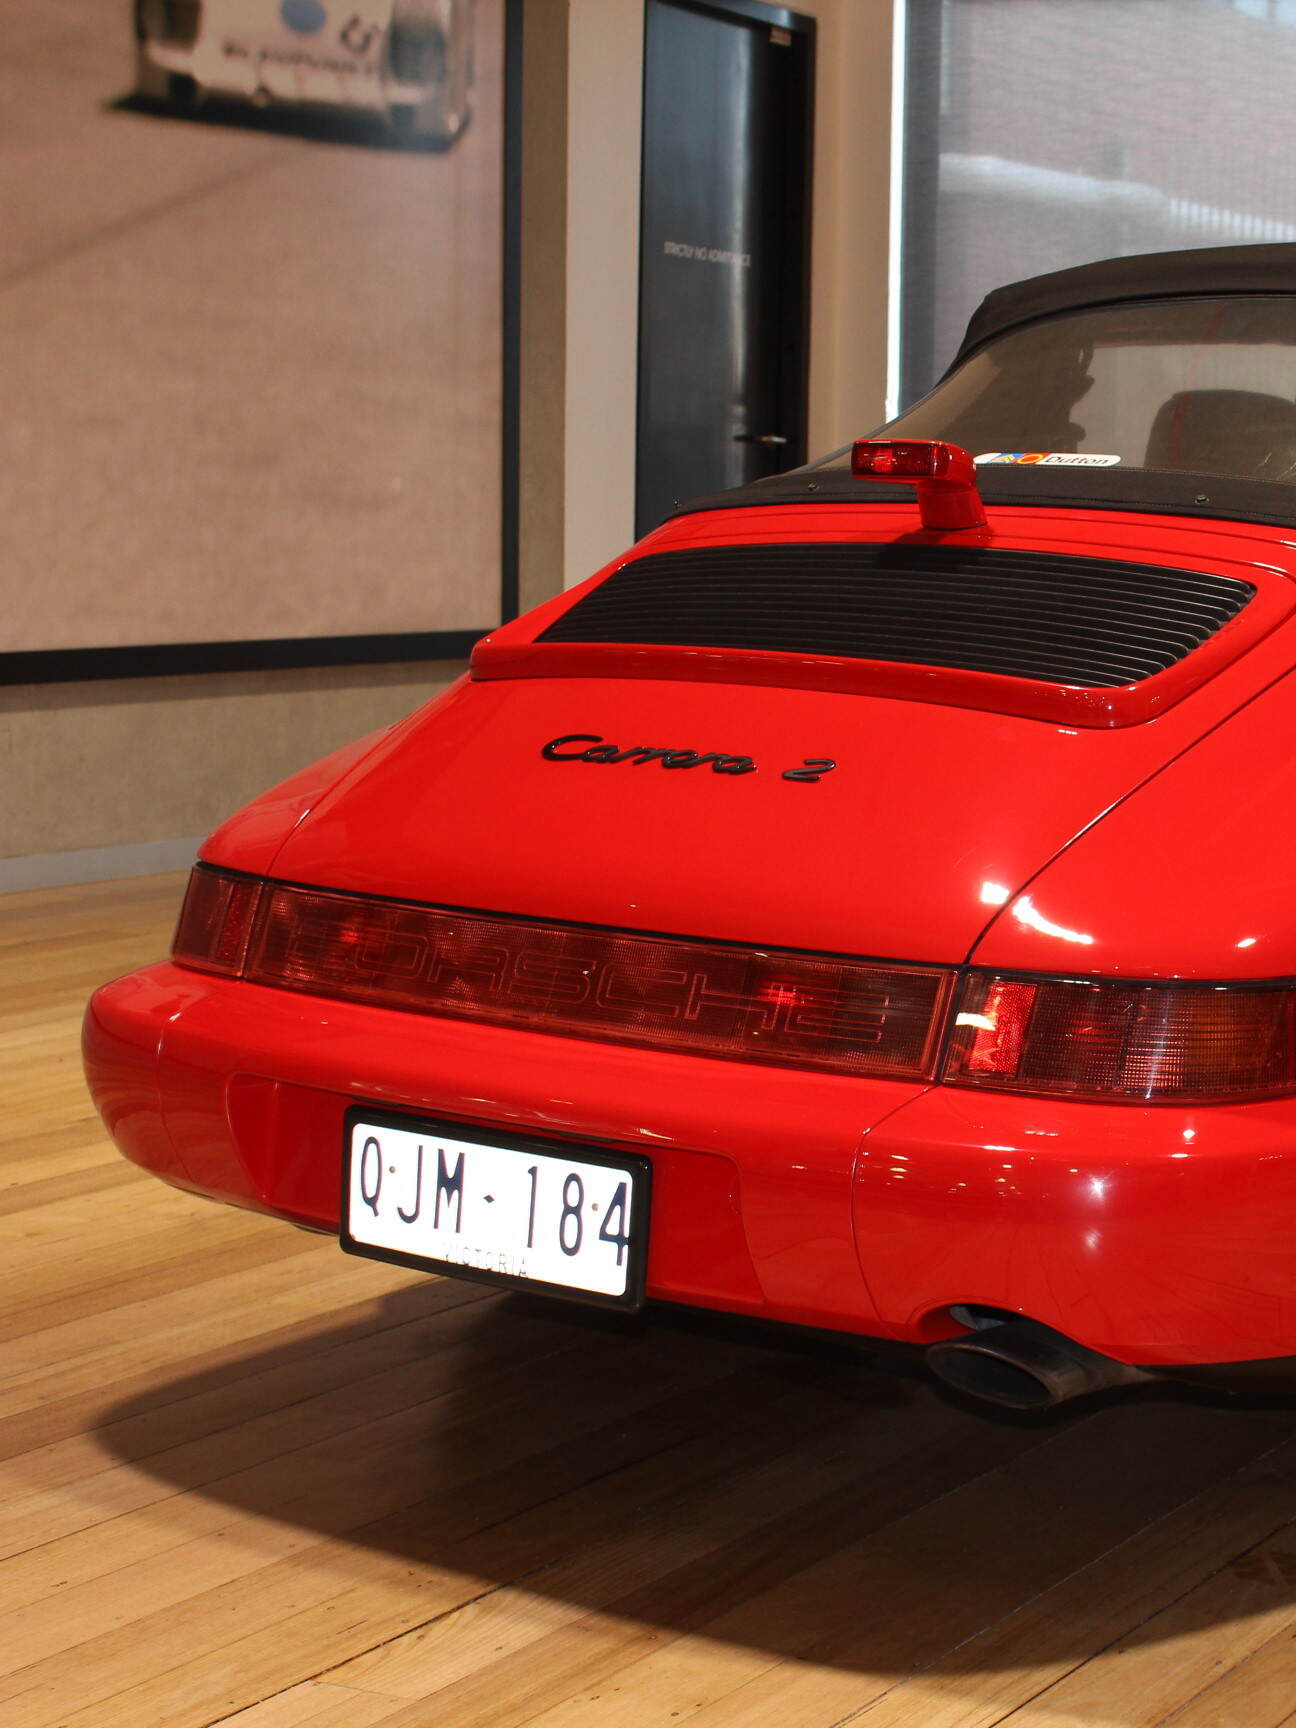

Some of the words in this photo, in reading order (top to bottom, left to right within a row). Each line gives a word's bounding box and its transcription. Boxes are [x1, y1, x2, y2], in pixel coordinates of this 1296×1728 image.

[1045, 455, 1109, 466] Dutton
[541, 734, 757, 774] Carrera
[782, 759, 836, 782] 2
